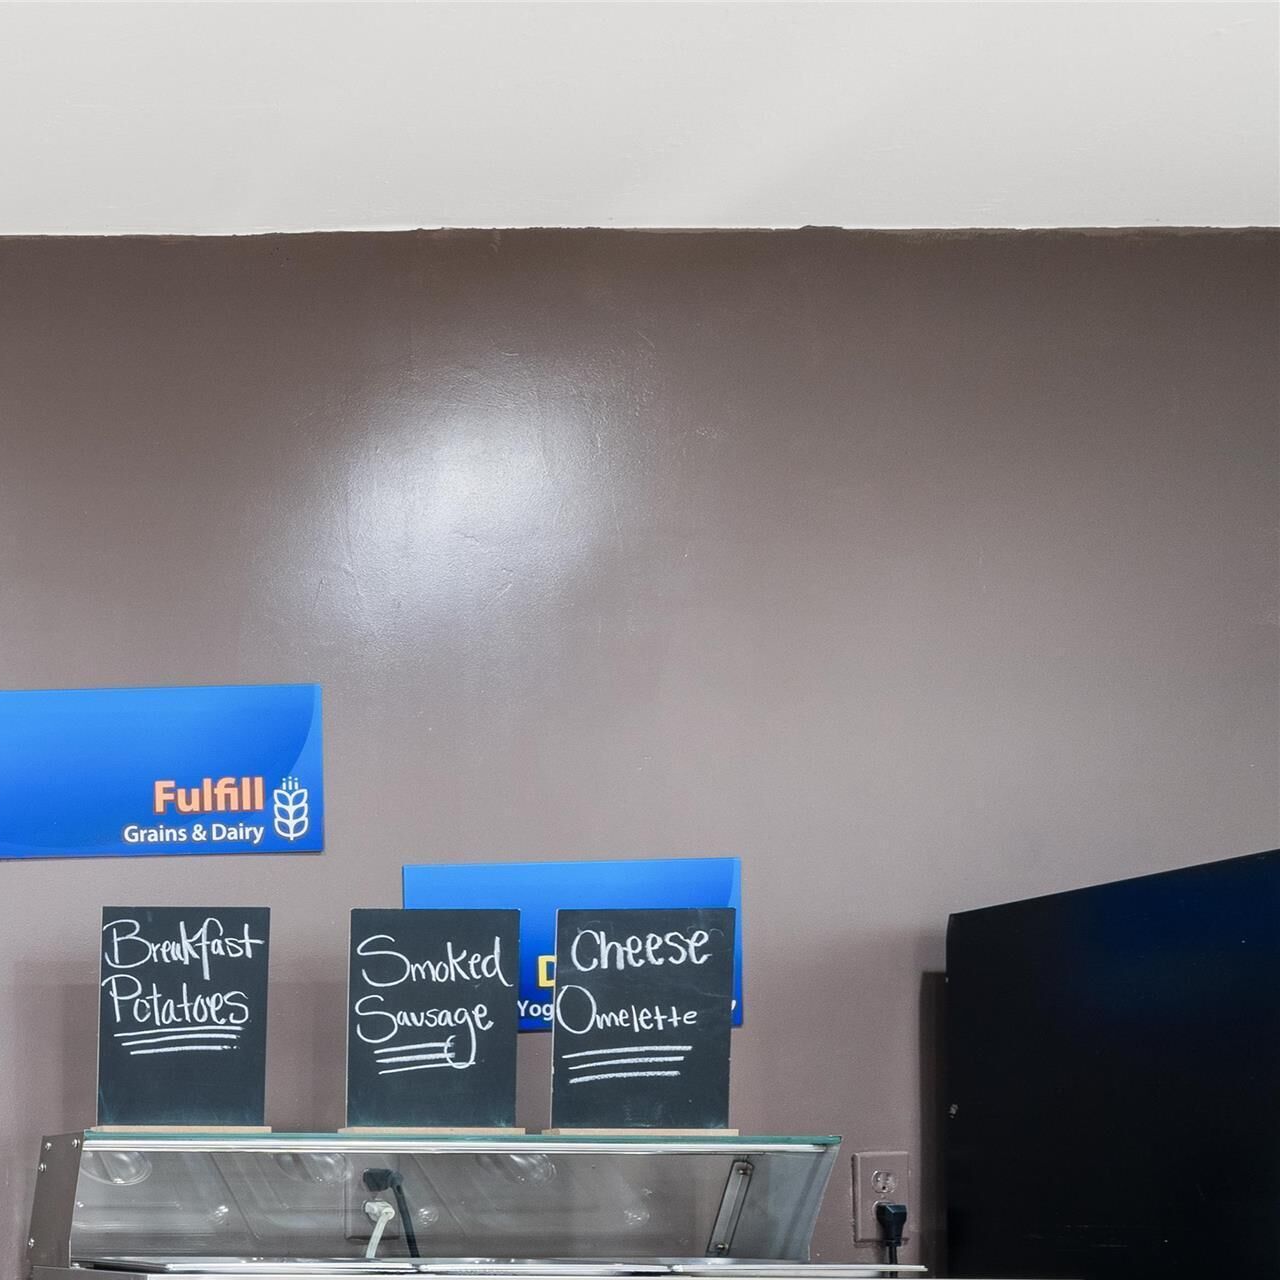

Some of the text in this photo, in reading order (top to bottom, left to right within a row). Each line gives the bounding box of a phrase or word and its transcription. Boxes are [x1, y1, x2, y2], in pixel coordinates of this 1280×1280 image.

[154, 777, 264, 813] Fulfill
[123, 823, 264, 845] Grains & Dairy
[102, 917, 265, 981] Breakfast
[356, 934, 514, 988] Smoked
[571, 929, 712, 972] Cheese
[101, 974, 249, 1026] Potatoes
[517, 1000, 555, 1021] Yog
[556, 984, 698, 1035] Omelette
[354, 994, 494, 1069] Sausage
